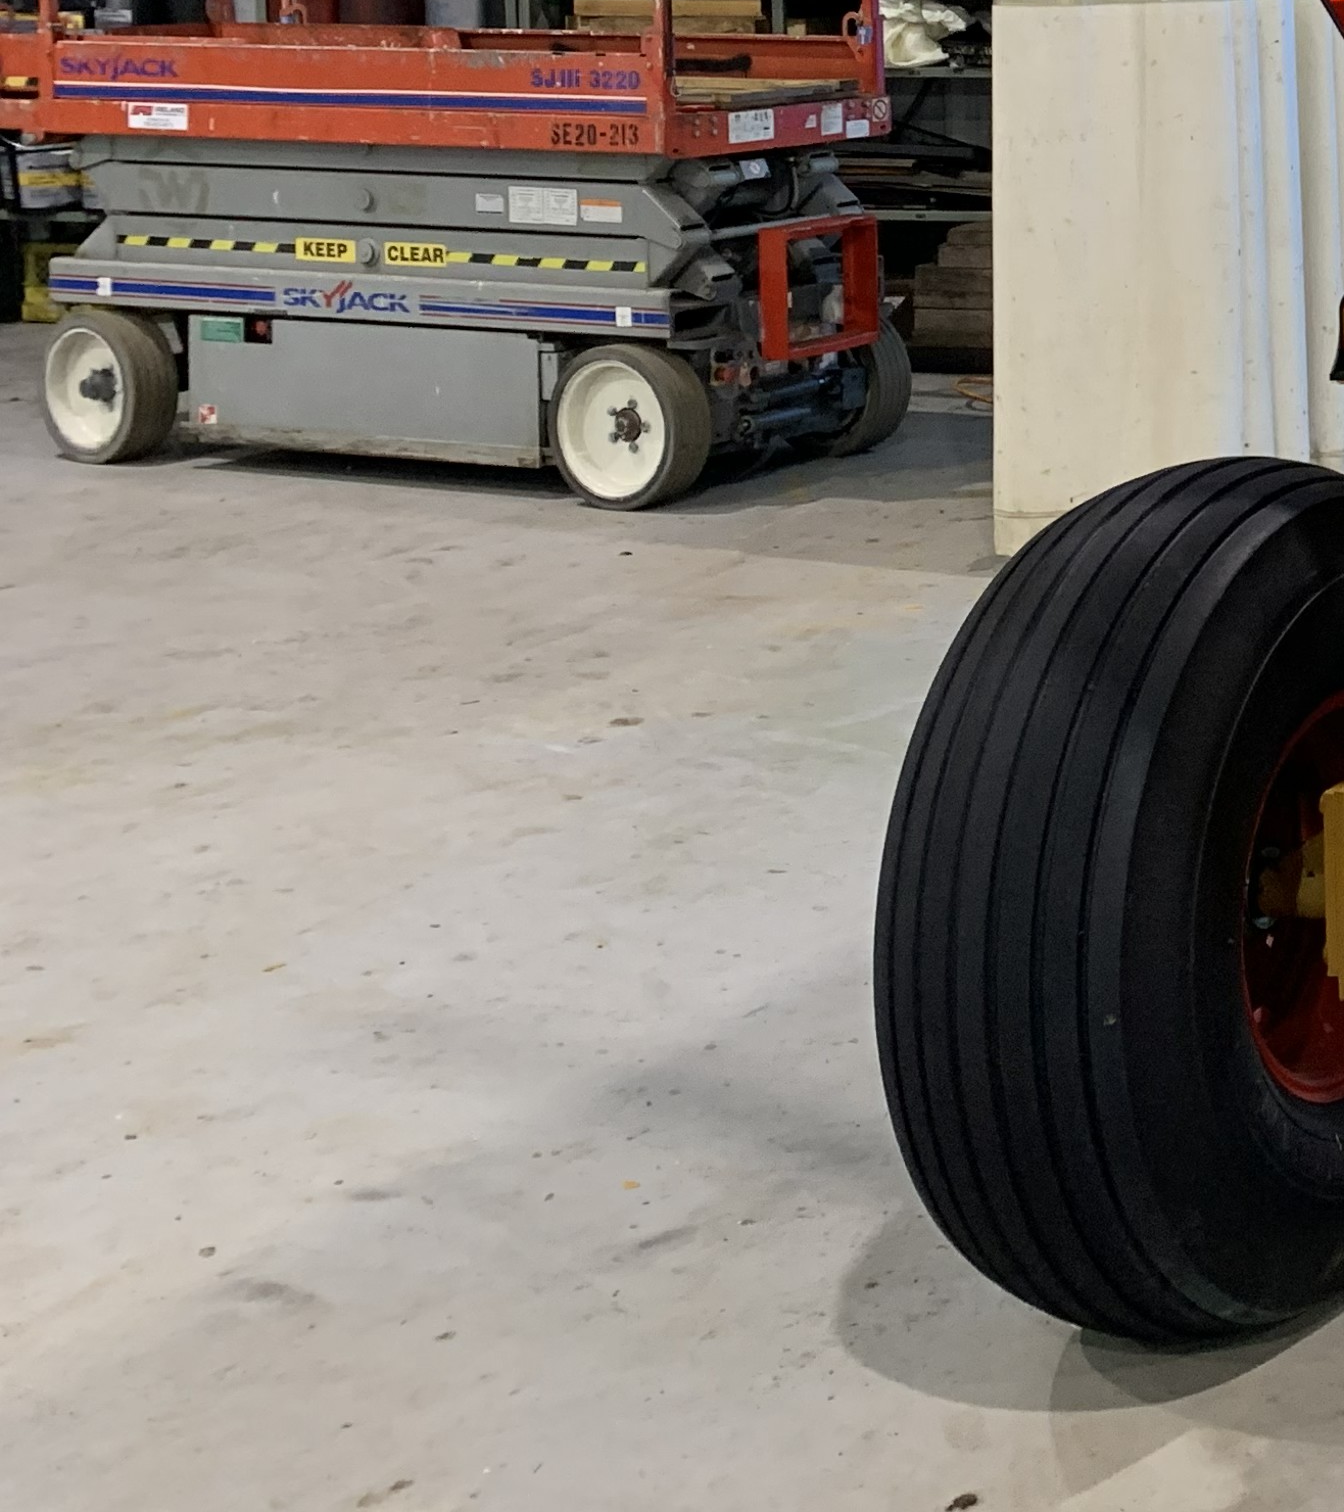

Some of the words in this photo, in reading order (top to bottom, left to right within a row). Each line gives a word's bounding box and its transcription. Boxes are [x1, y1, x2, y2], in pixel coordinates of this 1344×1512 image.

[60, 53, 178, 81] SKYJACK
[589, 70, 641, 90] 3220
[551, 122, 640, 147] SE20-213
[303, 241, 348, 258] KEEP
[387, 245, 445, 263] CLEAR
[283, 280, 411, 314] SKYJACK
